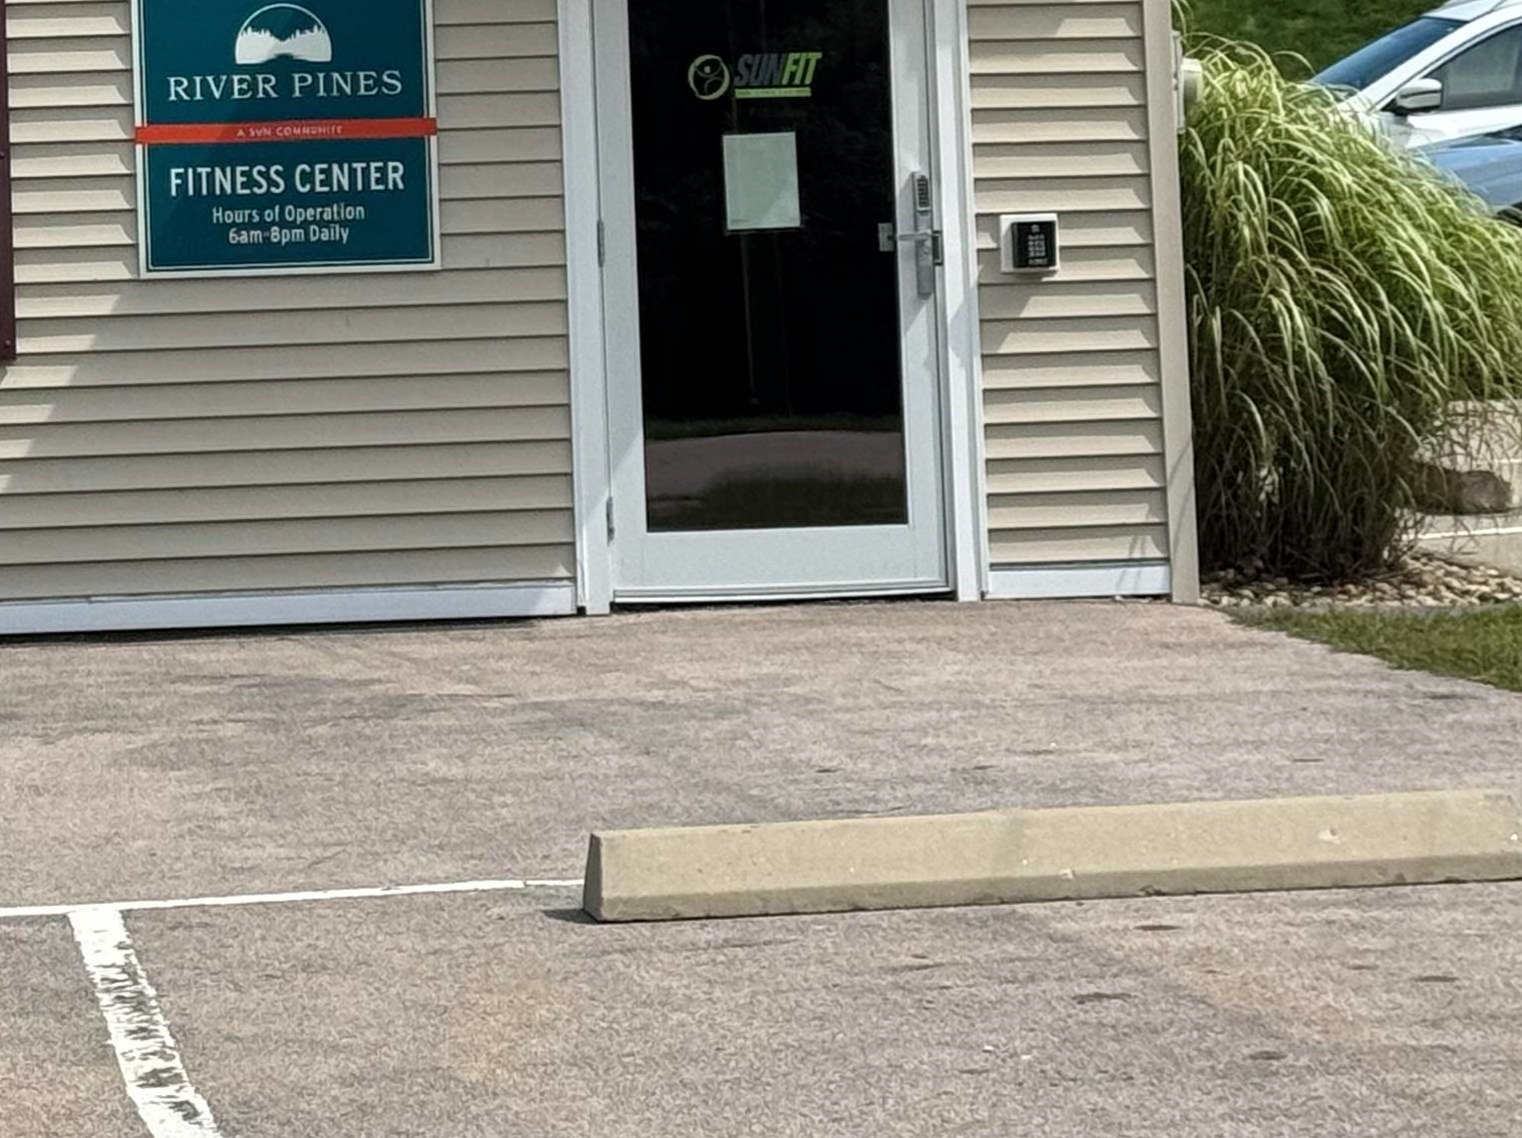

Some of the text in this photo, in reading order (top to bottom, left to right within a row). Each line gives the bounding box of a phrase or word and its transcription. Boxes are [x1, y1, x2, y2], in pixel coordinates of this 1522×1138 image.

[167, 70, 403, 101] RIVER PINES
[237, 128, 245, 137] A
[249, 127, 272, 137] SUN
[170, 161, 405, 197] FITNESS CENTER
[212, 203, 365, 224] Hours of Operation
[228, 224, 350, 246] 6am-8pm Daily
